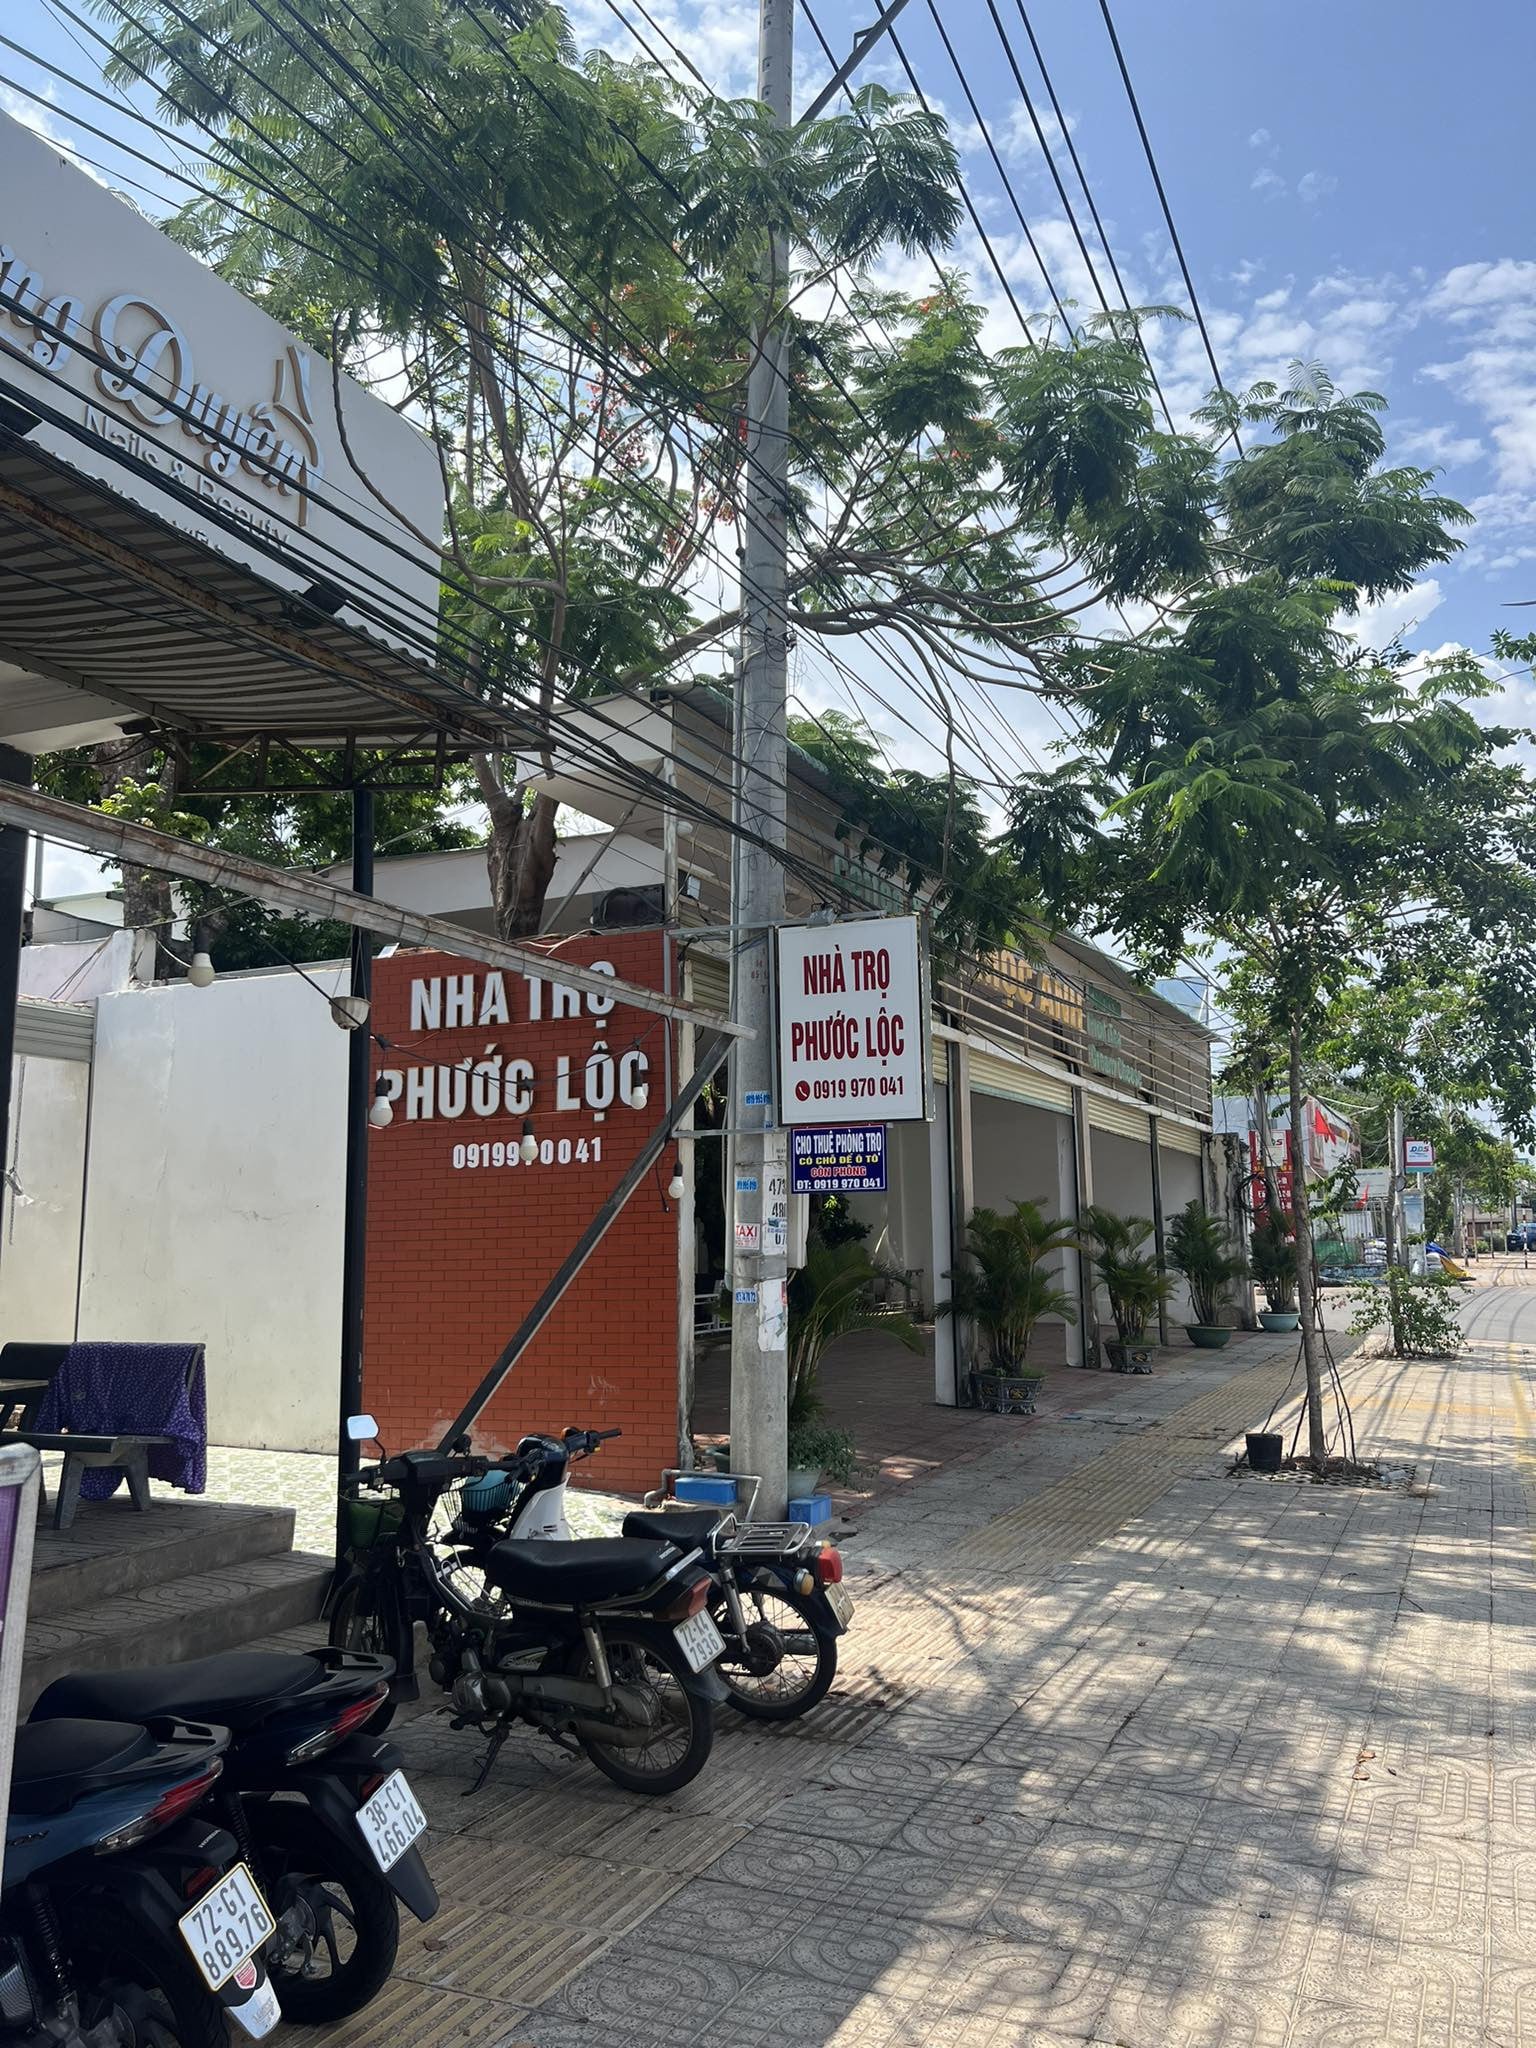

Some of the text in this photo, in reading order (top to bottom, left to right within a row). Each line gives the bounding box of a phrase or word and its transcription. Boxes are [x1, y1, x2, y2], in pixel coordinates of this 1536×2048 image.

[169, 460, 187, 485] &
[803, 944, 846, 995] NHÀ
[851, 948, 890, 999] TRỌ
[791, 1007, 904, 1066] PHƯỚC LỘC
[376, 1040, 649, 1122] PHƯỚC LỘC
[813, 1076, 903, 1099] 0919 970 041
[453, 1136, 601, 1169] 091990041
[795, 1135, 811, 1155] CHO
[813, 1130, 834, 1154] THUÊ
[836, 1129, 864, 1153] PHÒNG
[866, 1132, 882, 1156] TRỌ
[799, 1155, 813, 1165] CÓ
[866, 1153, 879, 1163] TÔ
[797, 1178, 881, 1189] ĐT: 0919 970 041
[811, 1164, 867, 1177] CÒN PHÒNG
[736, 1225, 758, 1237] TAXI
[680, 1614, 709, 1647] 72-K4
[690, 1632, 719, 1667] 7936
[366, 1779, 407, 1832] 38-C1
[377, 1802, 423, 1863] 466.04
[192, 1879, 246, 1944] 72-G1
[203, 1903, 268, 1980] 889.76
